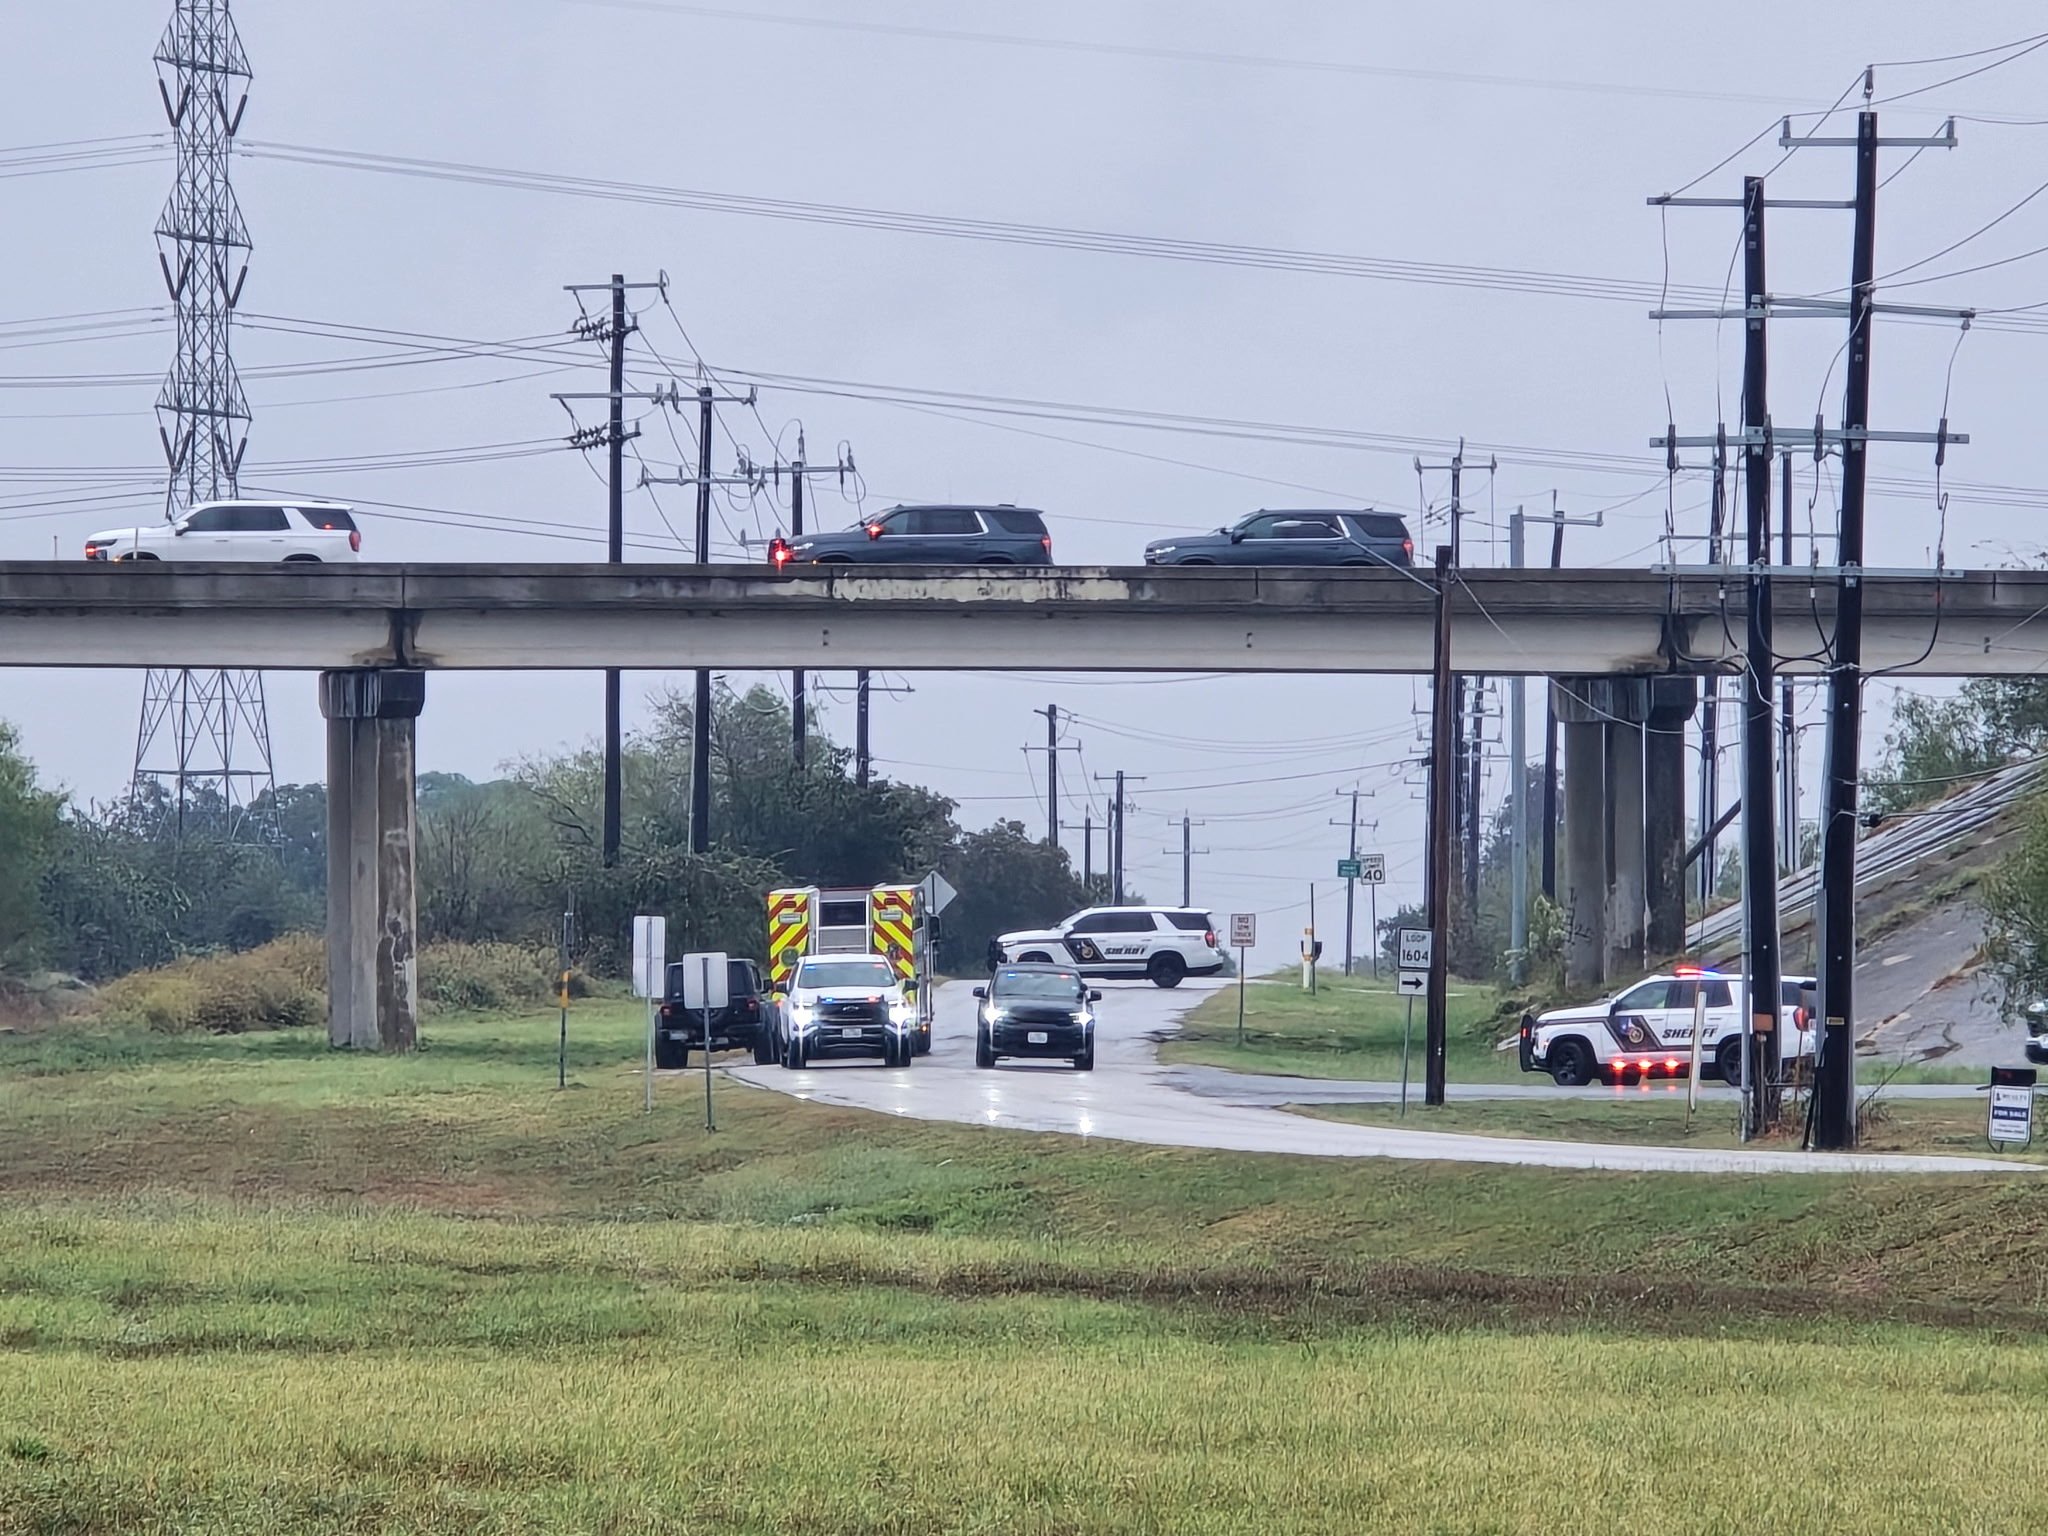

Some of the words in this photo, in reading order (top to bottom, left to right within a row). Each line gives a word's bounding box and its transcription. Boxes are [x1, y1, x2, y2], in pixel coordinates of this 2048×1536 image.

[1363, 869, 1383, 881] 40
[1406, 934, 1427, 943] LOOP
[1402, 949, 1429, 961] 1604
